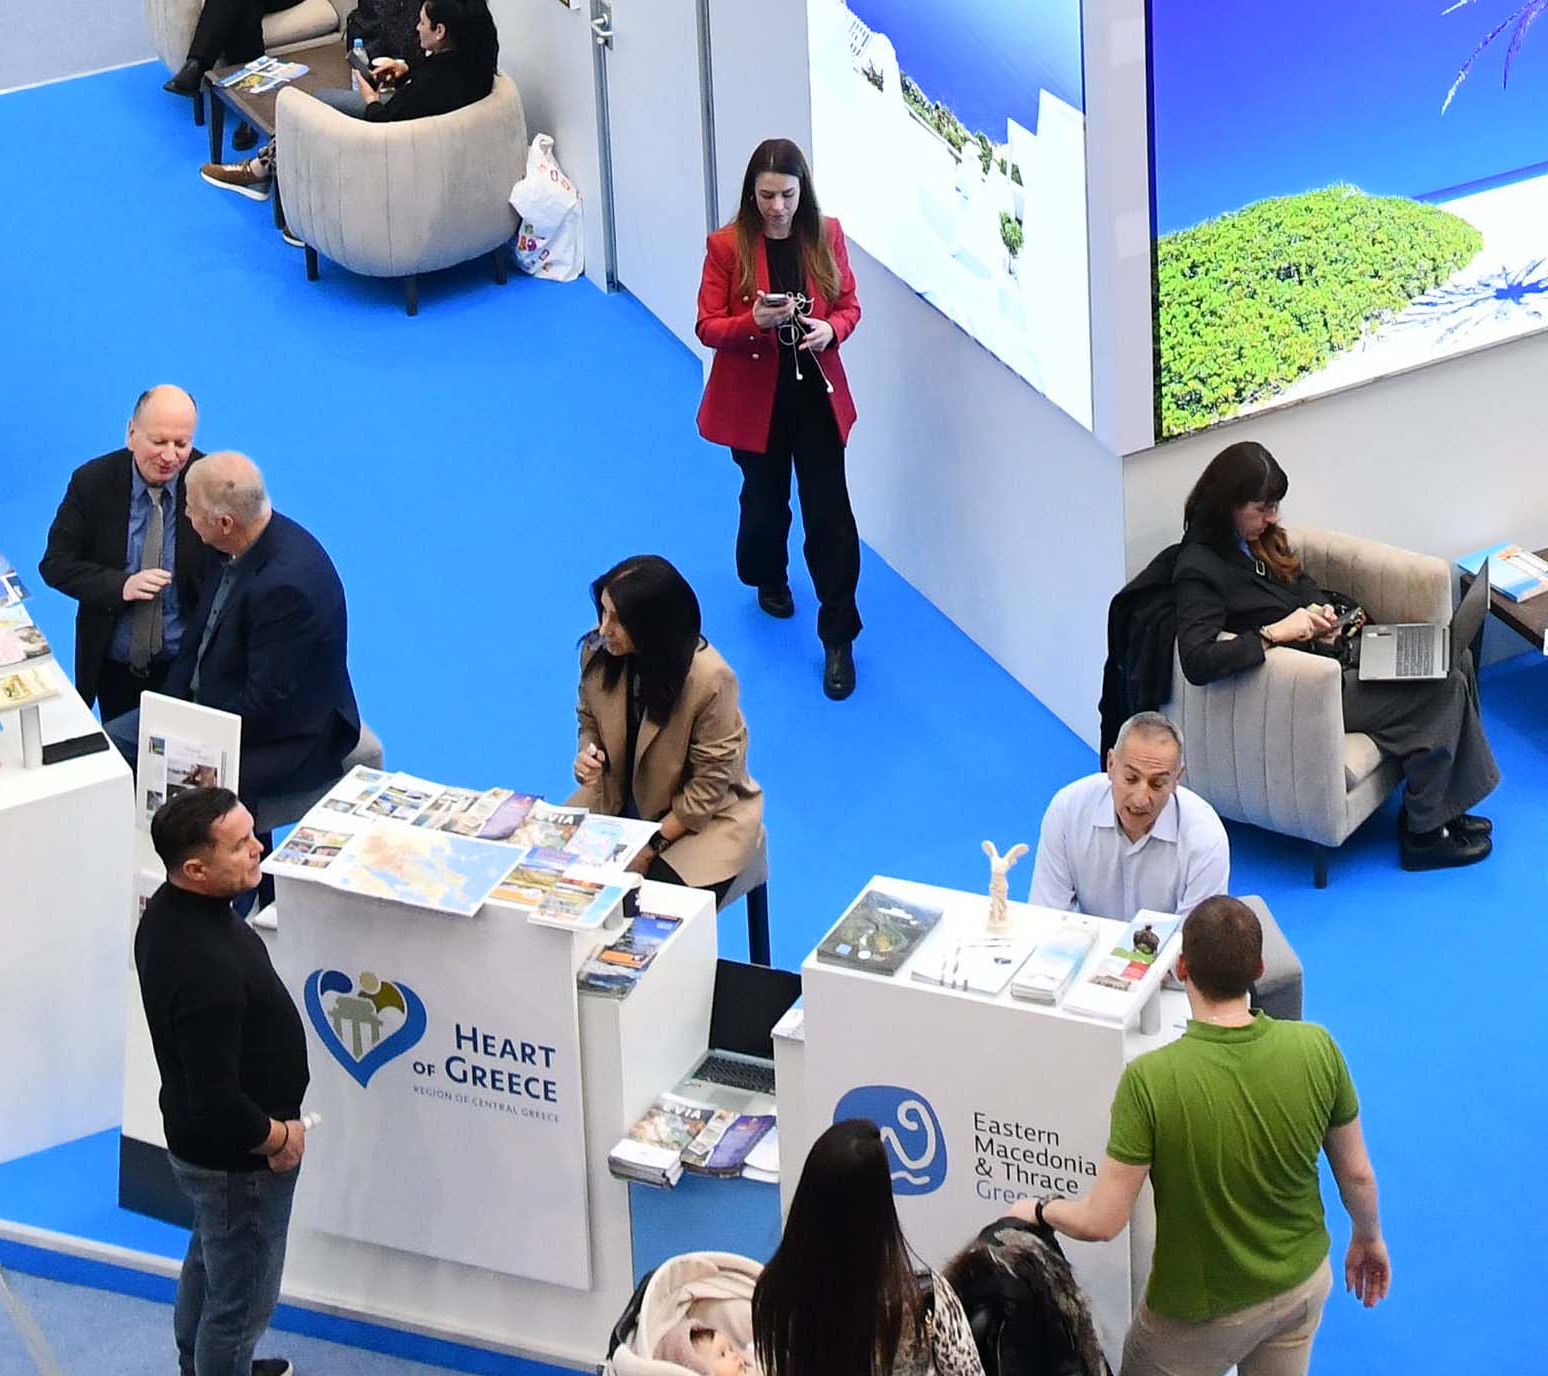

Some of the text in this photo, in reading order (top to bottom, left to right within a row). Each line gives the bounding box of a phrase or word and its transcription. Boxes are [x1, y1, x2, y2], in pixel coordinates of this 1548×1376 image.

[455, 1023, 556, 1069] HEART
[412, 1055, 558, 1104] OF GREECE
[413, 1086, 559, 1124] REGION OF CENTRAL GREECE
[973, 1111, 1060, 1148] Eastern
[973, 1134, 1099, 1179] Macedonia
[974, 1156, 1079, 1195] & Thrace
